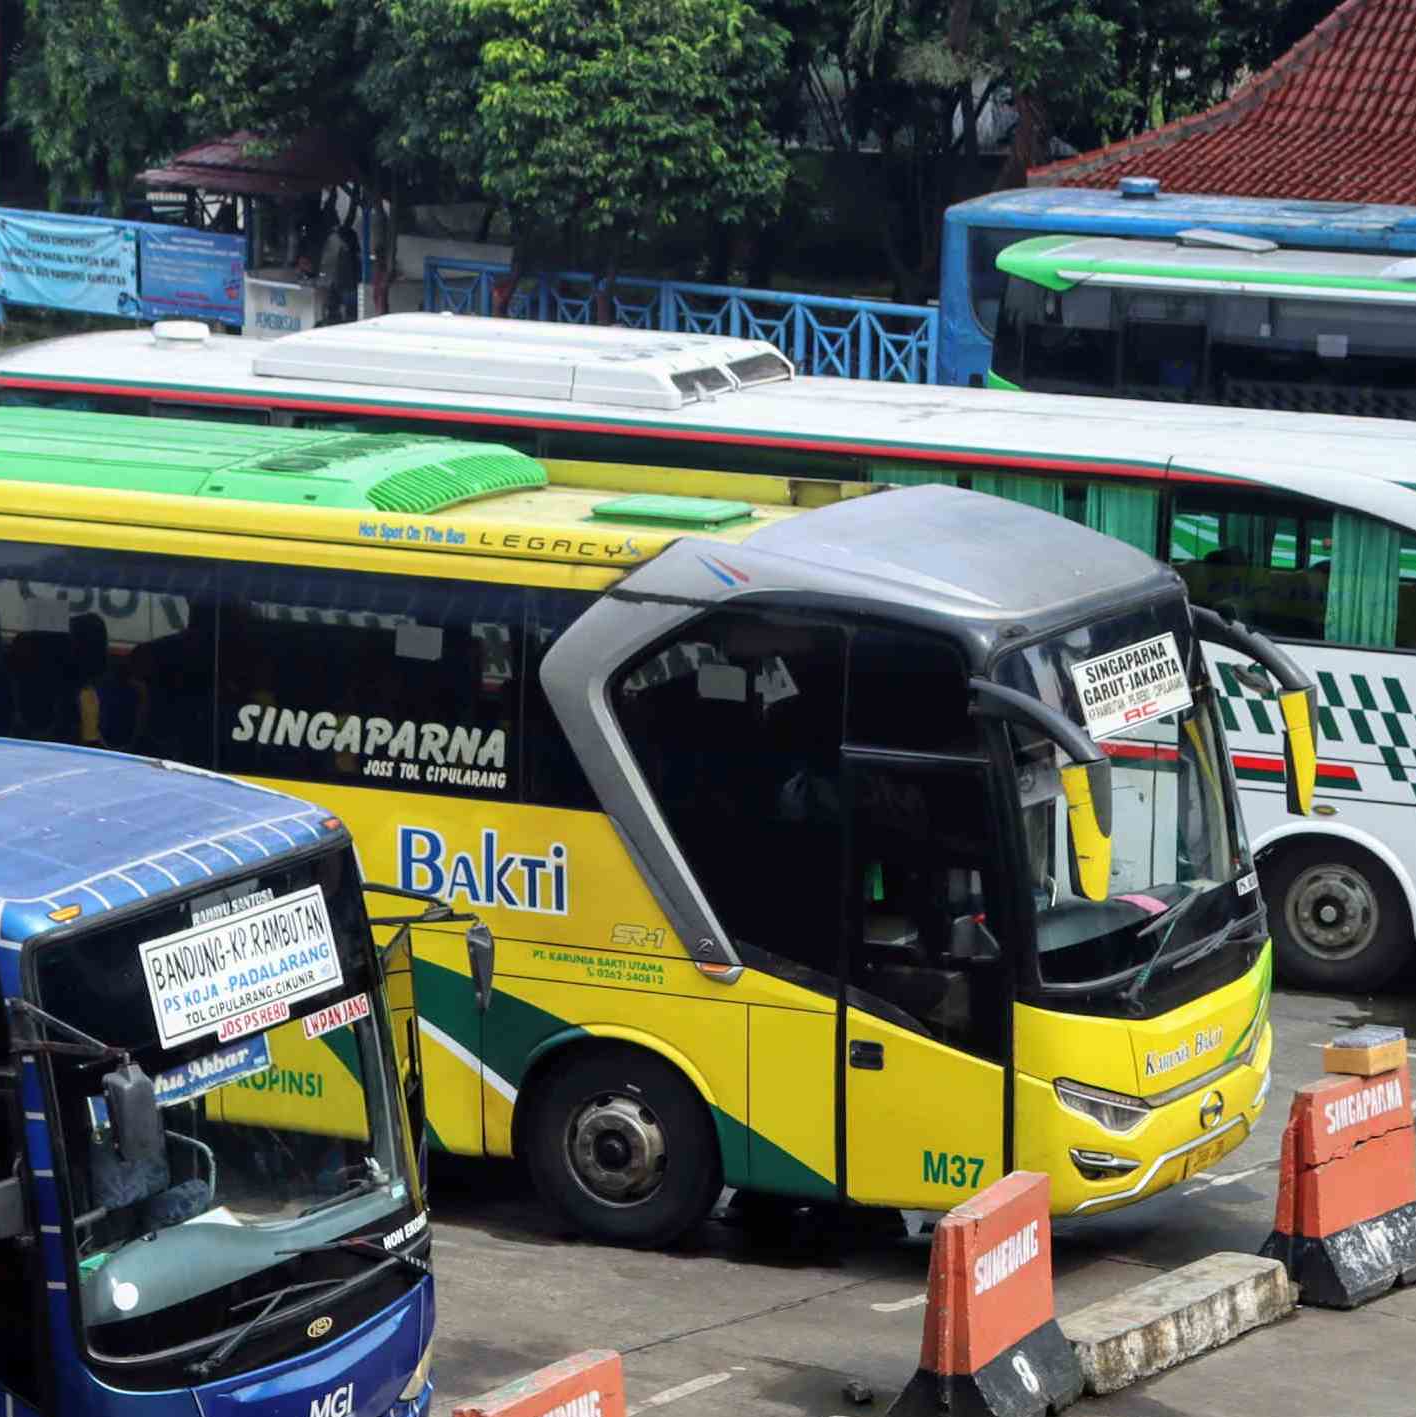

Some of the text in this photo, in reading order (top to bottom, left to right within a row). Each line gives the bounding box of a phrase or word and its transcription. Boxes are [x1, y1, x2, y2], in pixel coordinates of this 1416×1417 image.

[480, 531, 623, 558] LEGACY
[1083, 657, 1180, 706] GARUT-JAKARTA
[1085, 641, 1168, 684] SINGAPARNA
[232, 704, 505, 768] SINGAPARNA
[363, 759, 507, 789] JOSS TOL CIPULARANG
[163, 994, 183, 1014] PS
[184, 1008, 207, 1026] TOL
[1323, 1078, 1404, 1135] SINGAPARNA
[922, 1150, 985, 1189] M37
[973, 1219, 1039, 1296] SUMEDANG
[1012, 1355, 1040, 1394] 8
